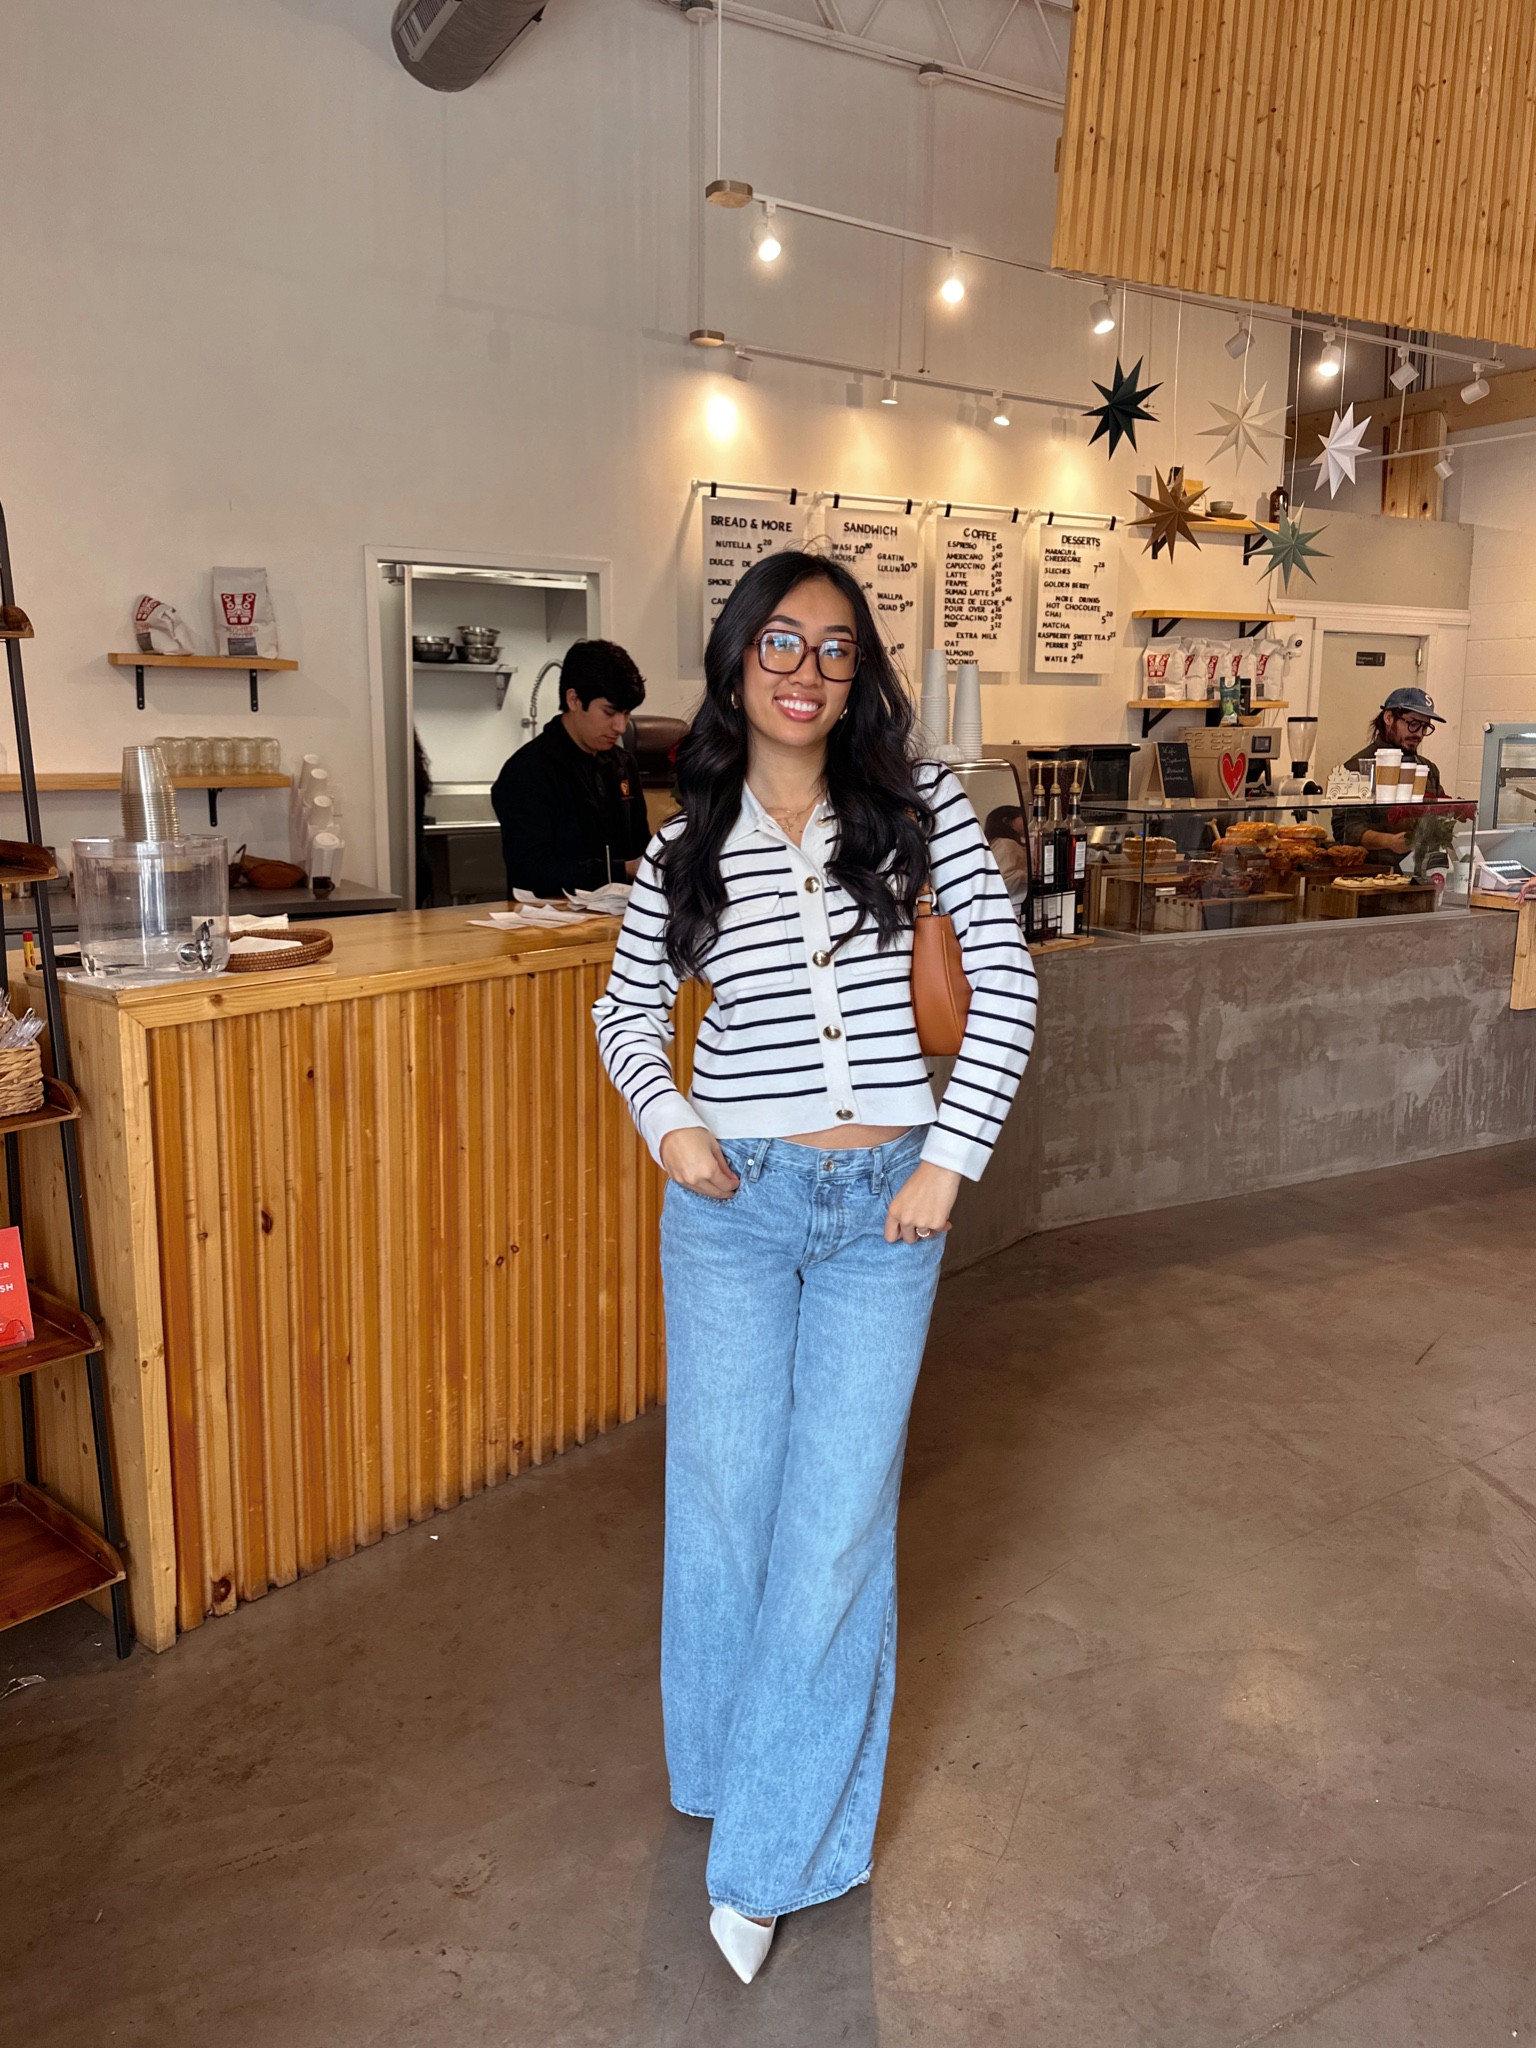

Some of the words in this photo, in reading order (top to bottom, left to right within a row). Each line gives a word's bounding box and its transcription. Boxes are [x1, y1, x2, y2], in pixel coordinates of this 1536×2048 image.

[711, 515, 747, 528] BREAD
[751, 519, 757, 529] &
[761, 520, 792, 532] MORE
[844, 522, 898, 536] SANDWICH
[963, 528, 997, 541] COFFEE
[716, 540, 752, 549] NUTELLA
[1062, 535, 1100, 547] DESSERTS
[877, 553, 904, 561] GRATIN
[1045, 555, 1081, 563] CHEESECAKE
[710, 558, 734, 566] DULCE
[946, 562, 986, 570] CAPUCCINO
[877, 592, 903, 600] WALLPA
[878, 603, 897, 611] QUAD
[1065, 604, 1101, 612] CHOCOLATE
[944, 614, 988, 622] MOCCACINO
[1425, 694, 1432, 706] S
